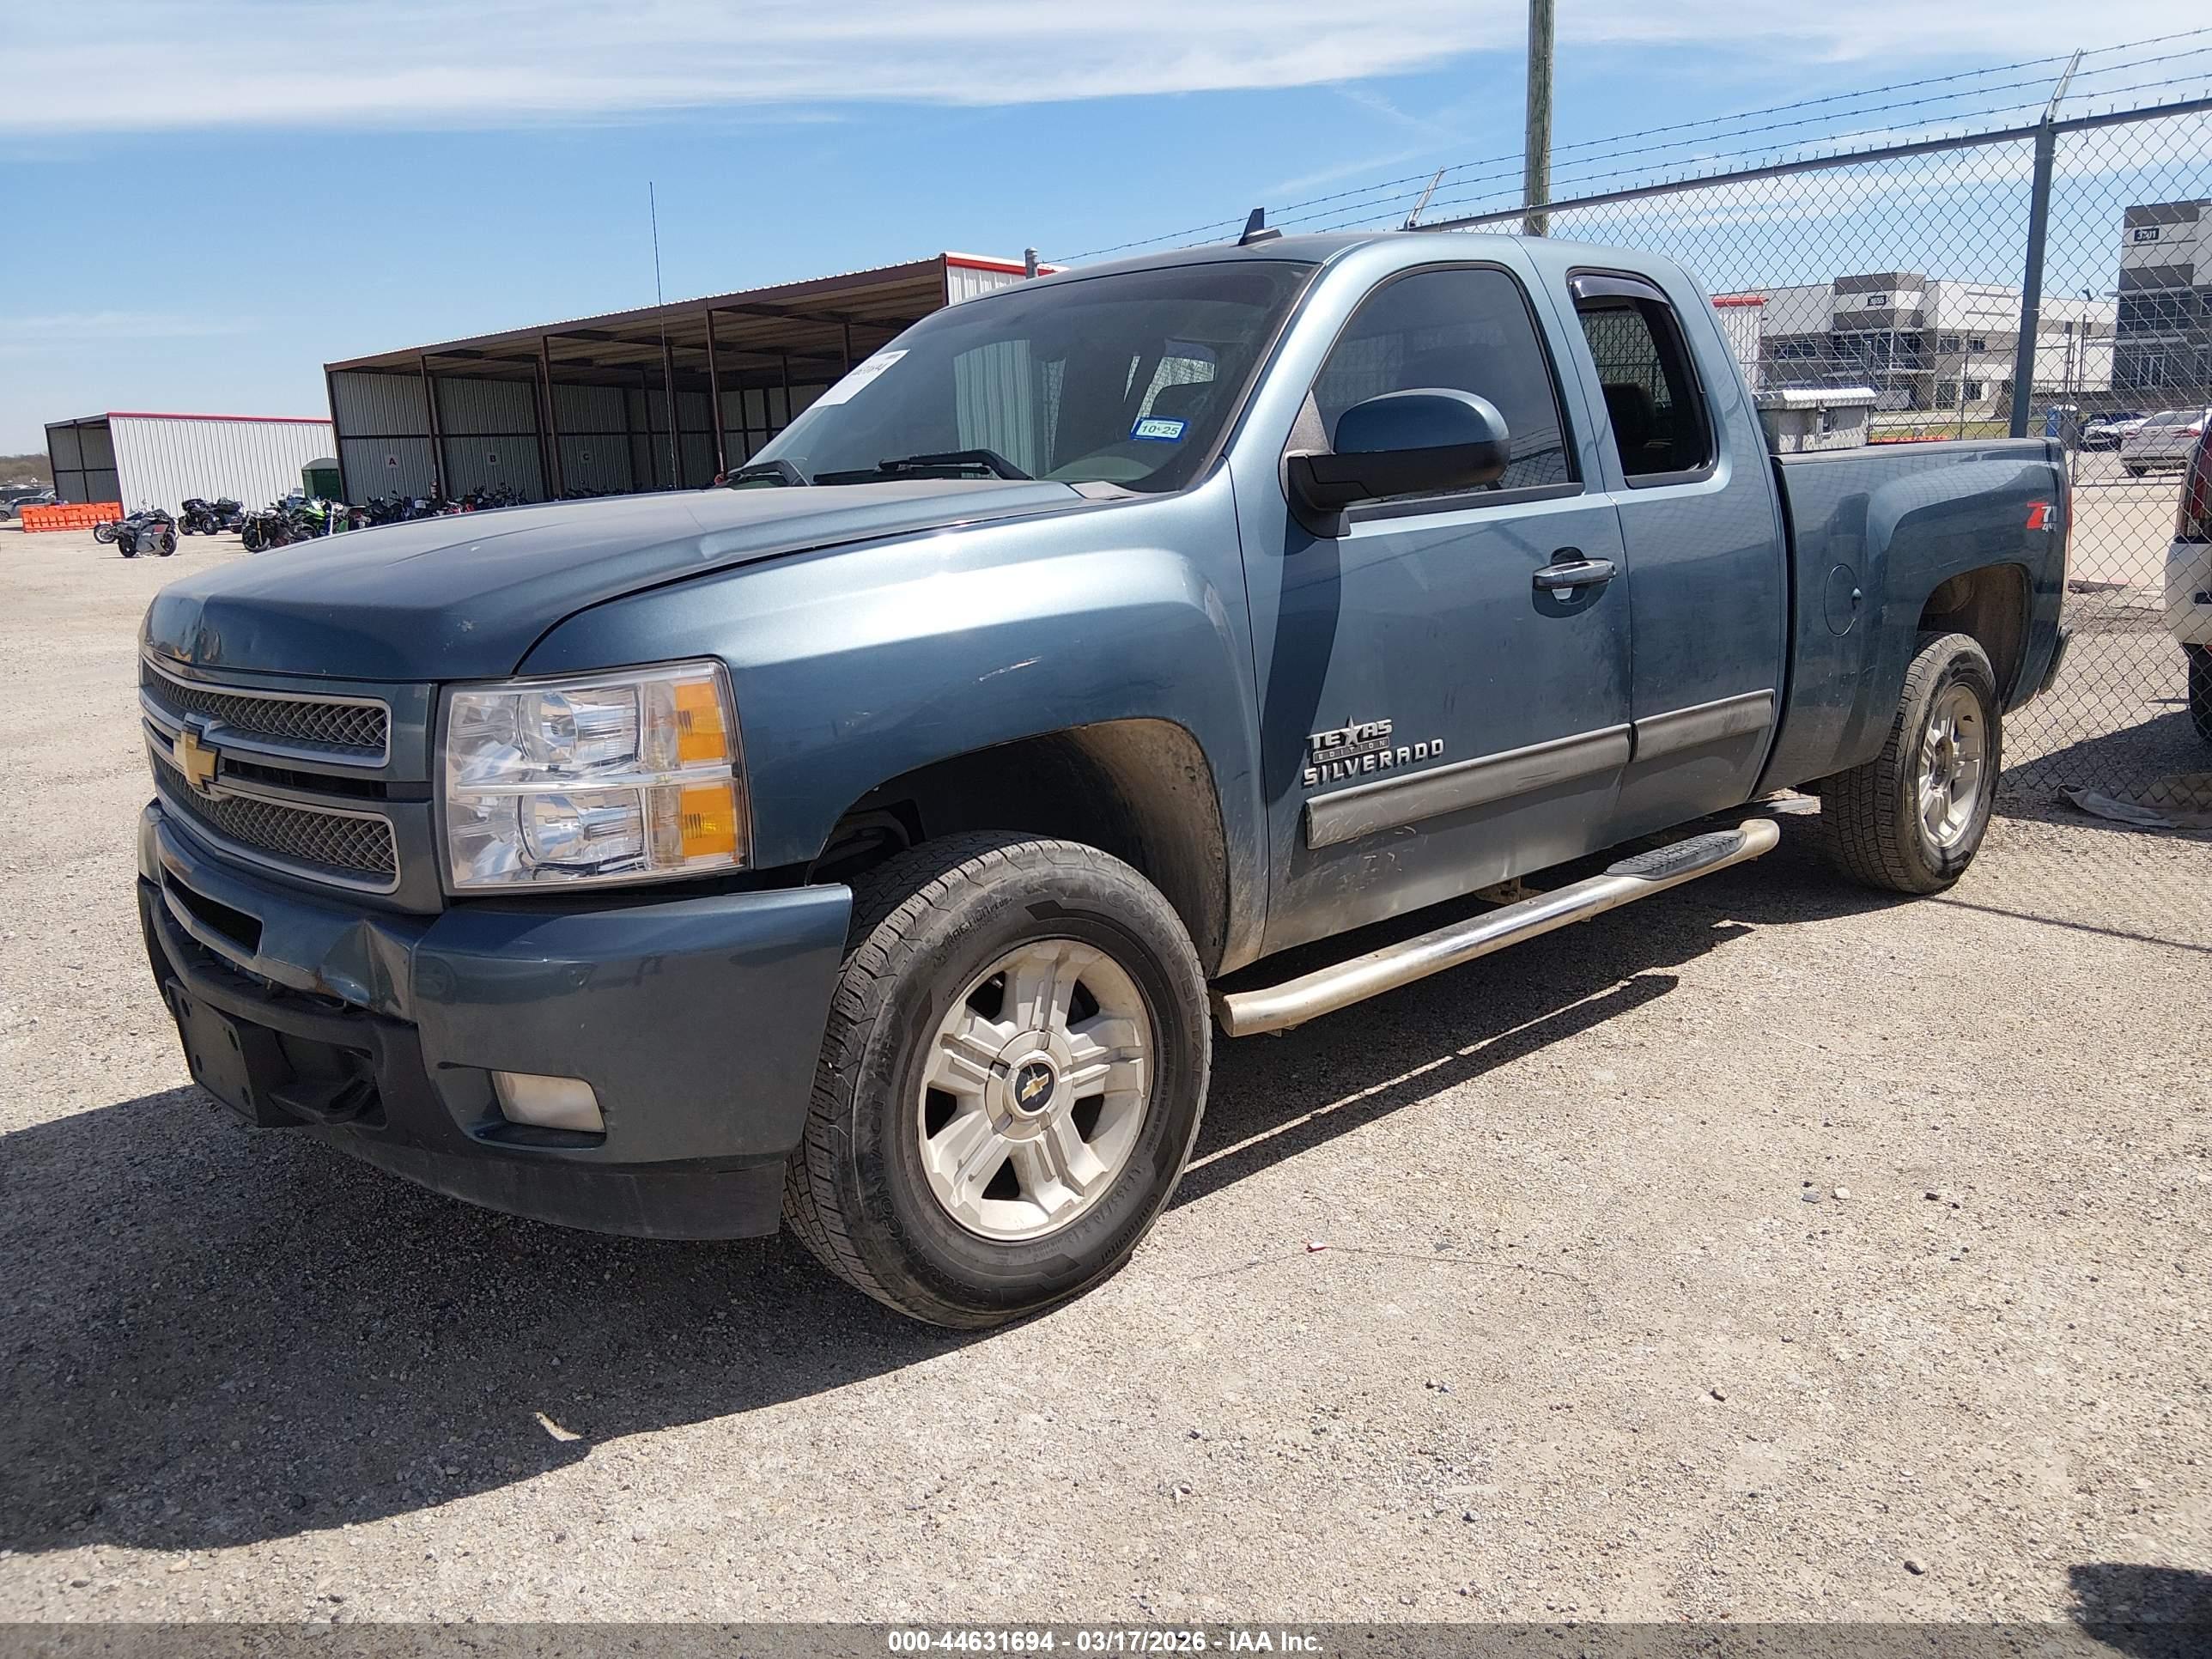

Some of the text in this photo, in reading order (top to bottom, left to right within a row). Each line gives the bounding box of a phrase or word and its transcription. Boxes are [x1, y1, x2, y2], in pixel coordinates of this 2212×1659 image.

[1306, 716, 1393, 749] TEXAS
[1304, 738, 1444, 786] SILVERADO
[1318, 740, 1387, 761] EDITION
